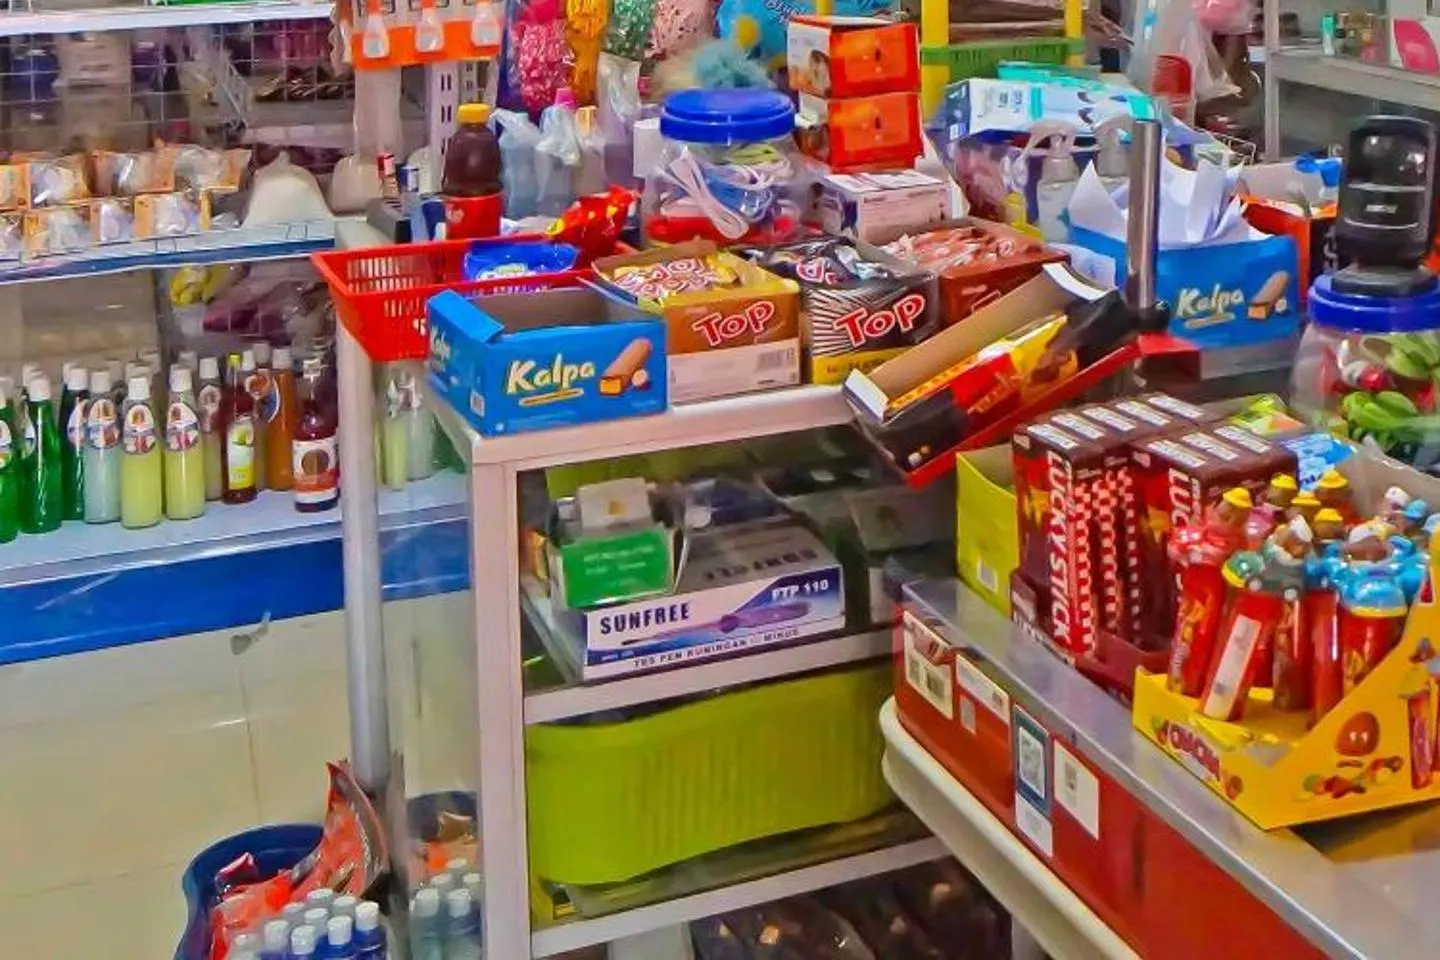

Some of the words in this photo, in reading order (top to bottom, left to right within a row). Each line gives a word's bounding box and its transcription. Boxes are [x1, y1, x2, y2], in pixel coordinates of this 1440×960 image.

[1176, 283, 1245, 317] Kalpa
[506, 353, 596, 394] Kalpa
[803, 579, 829, 594] 110
[600, 602, 690, 635] SUNFREE
[660, 652, 682, 664] PEN
